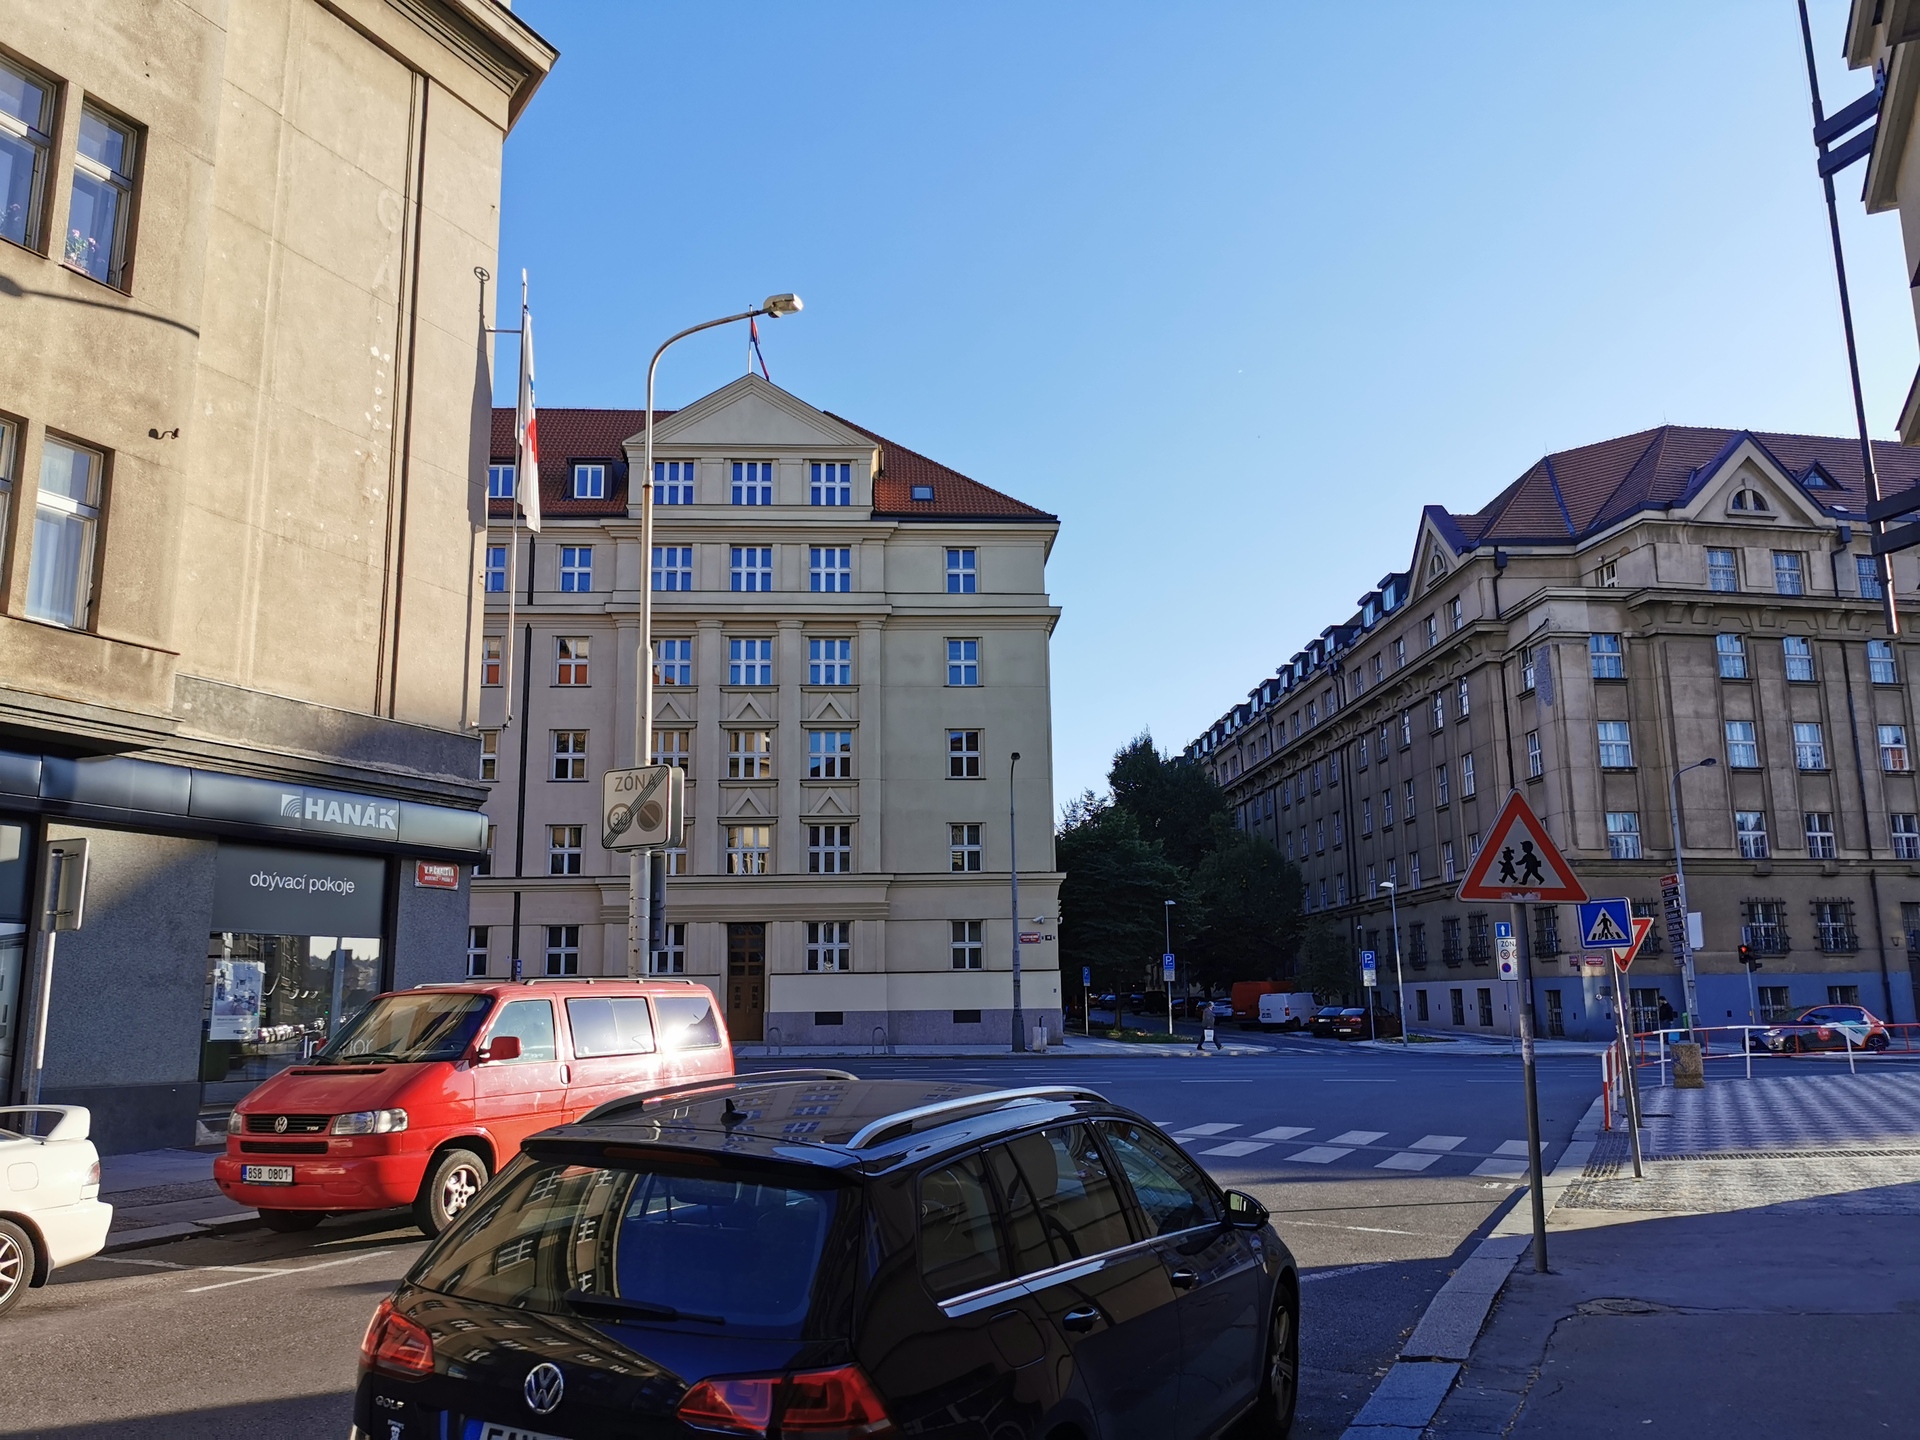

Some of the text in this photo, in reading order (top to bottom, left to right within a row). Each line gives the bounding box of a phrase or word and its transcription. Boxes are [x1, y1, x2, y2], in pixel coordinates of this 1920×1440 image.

[304, 797, 397, 831] HANÁK
[249, 871, 355, 896] obývací pokoje
[248, 1167, 289, 1180] 8S8 0801
